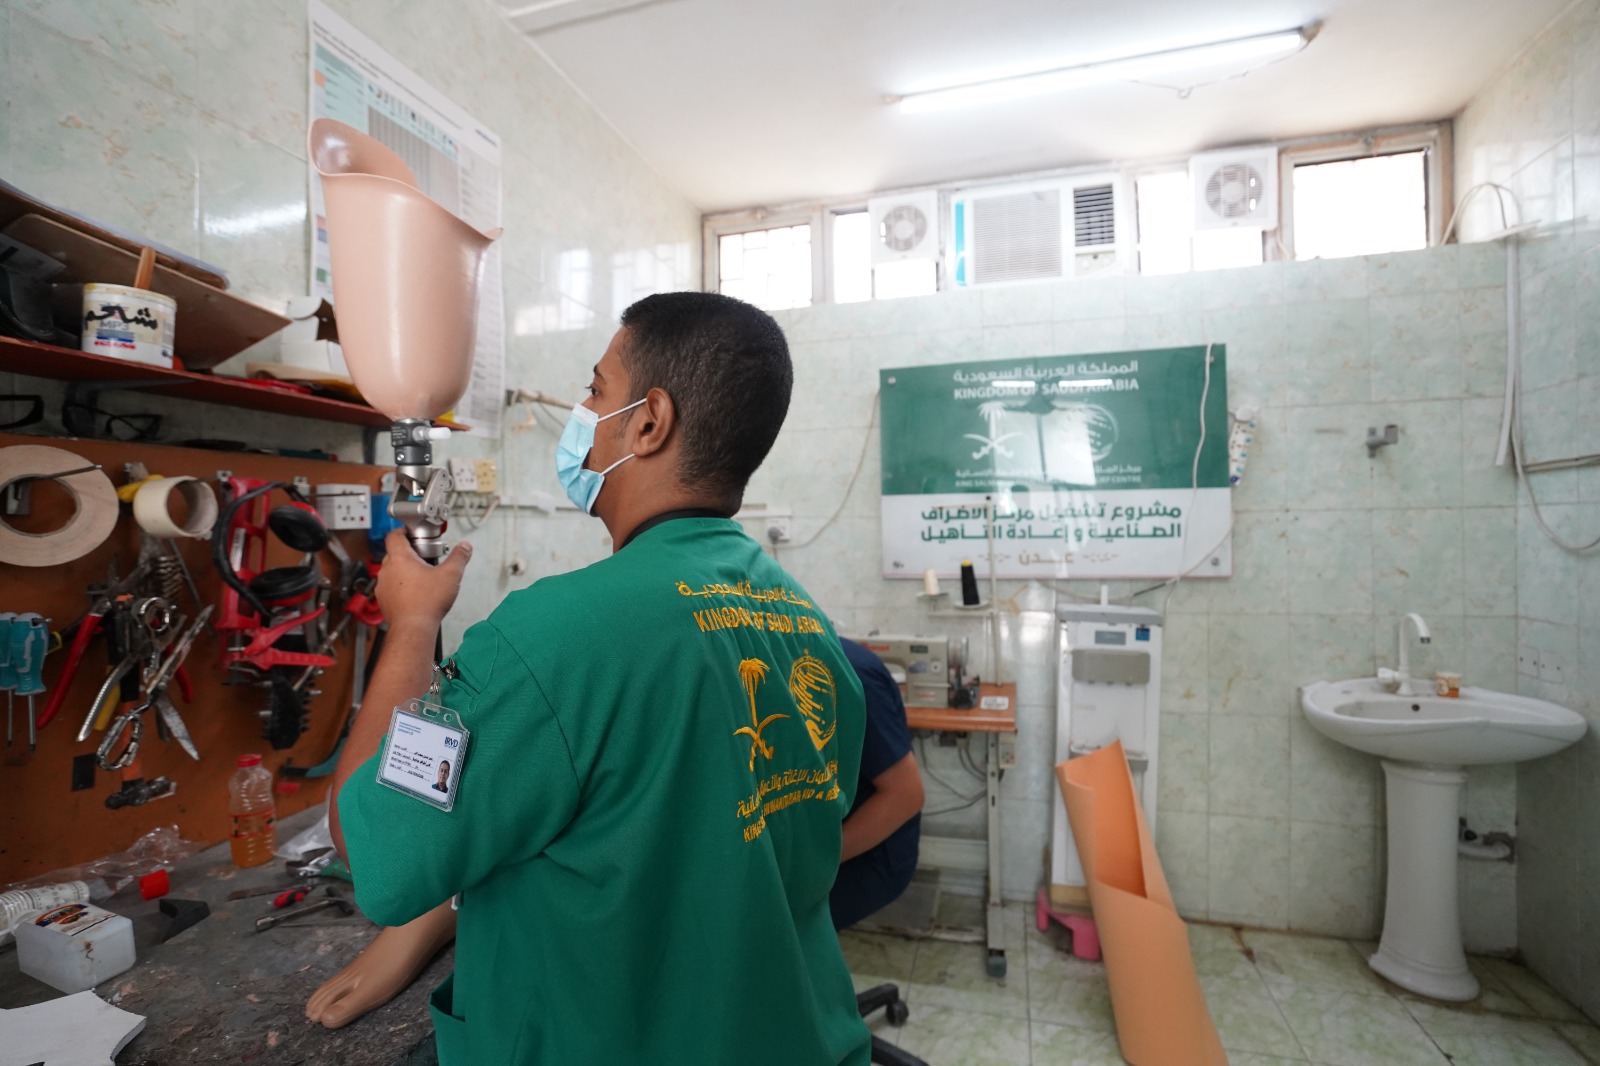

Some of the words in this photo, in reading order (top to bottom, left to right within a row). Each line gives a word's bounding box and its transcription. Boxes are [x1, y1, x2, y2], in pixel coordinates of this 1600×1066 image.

[953, 367, 1021, 383] السعودية
[1024, 363, 1075, 381] العربية
[1077, 359, 1139, 376] المملكة
[953, 382, 1020, 400] KINGDOM
[1022, 382, 1037, 396] OF
[1042, 379, 1081, 396] SAUDI
[1082, 377, 1140, 395] ARABIA
[1111, 499, 1182, 521] مشروع
[1006, 523, 1069, 543] إعادة
[1074, 526, 1083, 542] و
[1088, 522, 1182, 543] الصناعية
[1019, 549, 1074, 566] عدن
